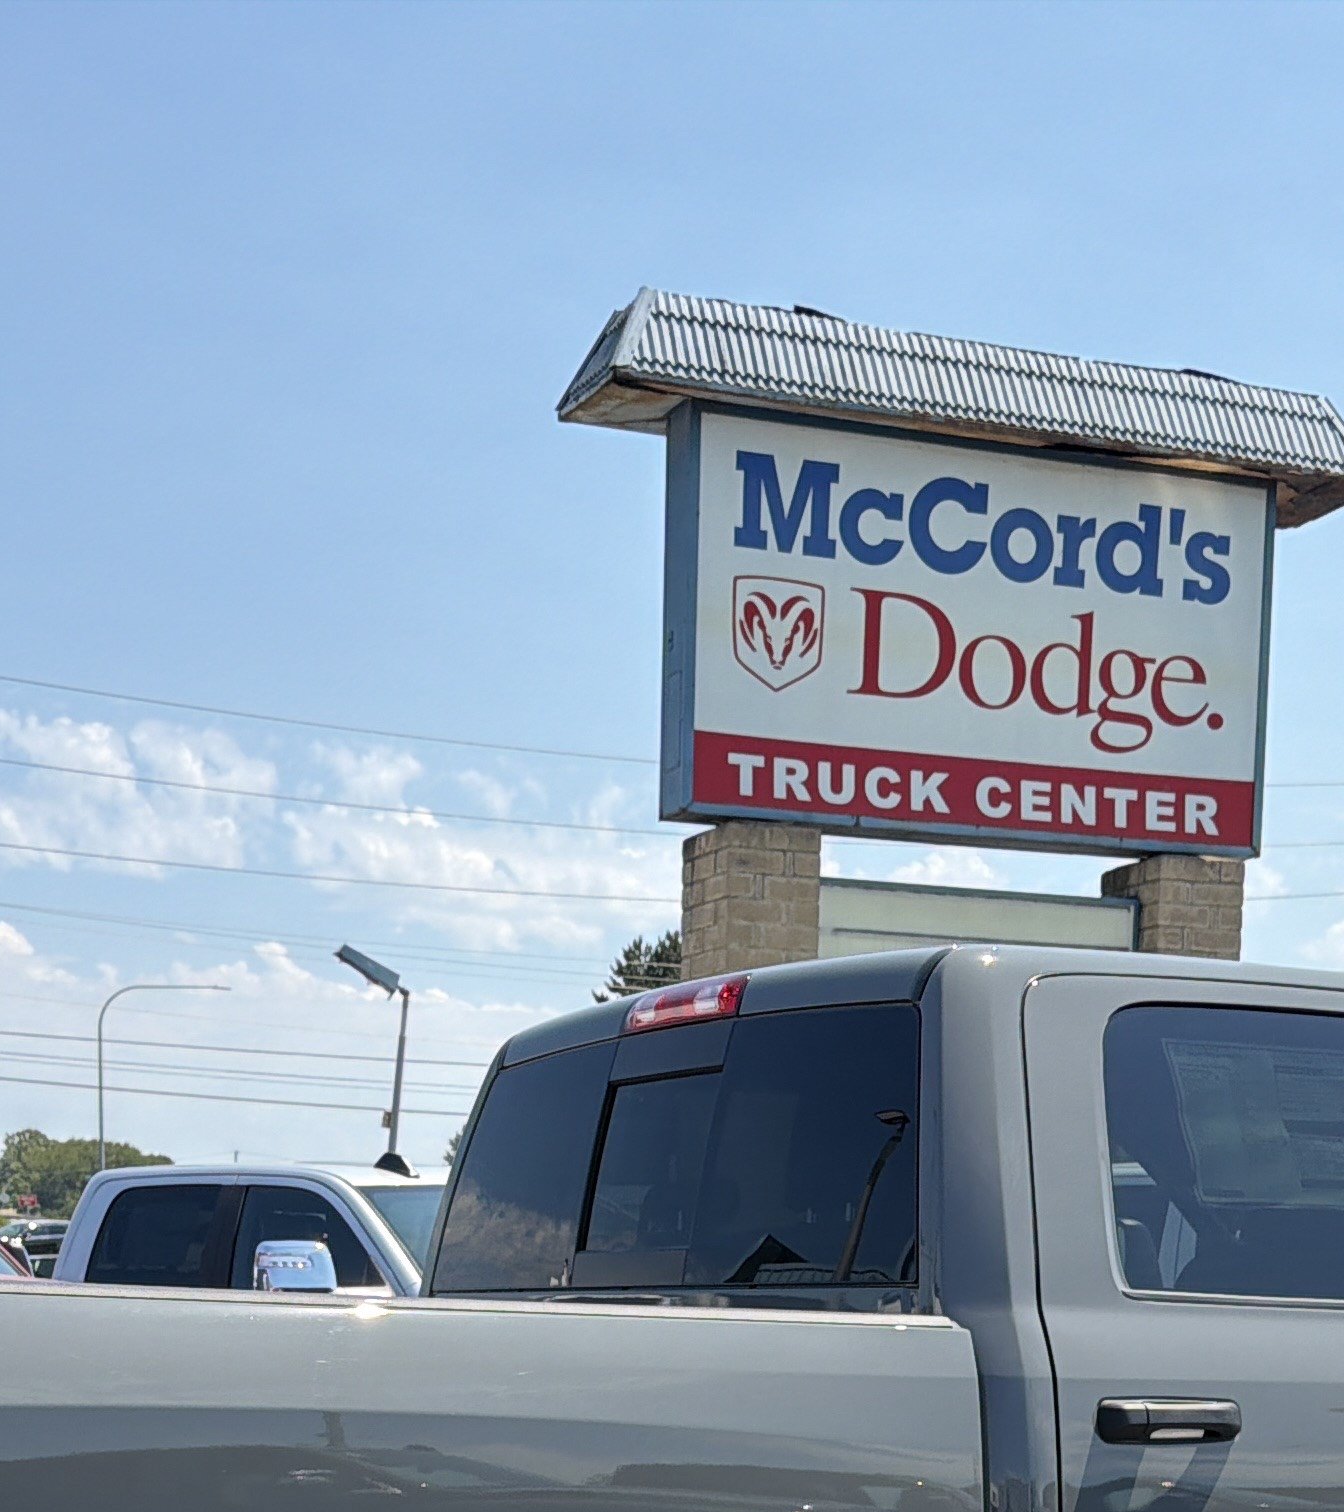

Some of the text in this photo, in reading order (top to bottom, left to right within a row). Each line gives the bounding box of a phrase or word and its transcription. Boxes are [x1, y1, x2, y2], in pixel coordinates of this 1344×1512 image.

[734, 449, 1232, 606] McCord's
[846, 586, 1226, 755] Dodge.
[727, 752, 1222, 837] TRUCK CENTER
